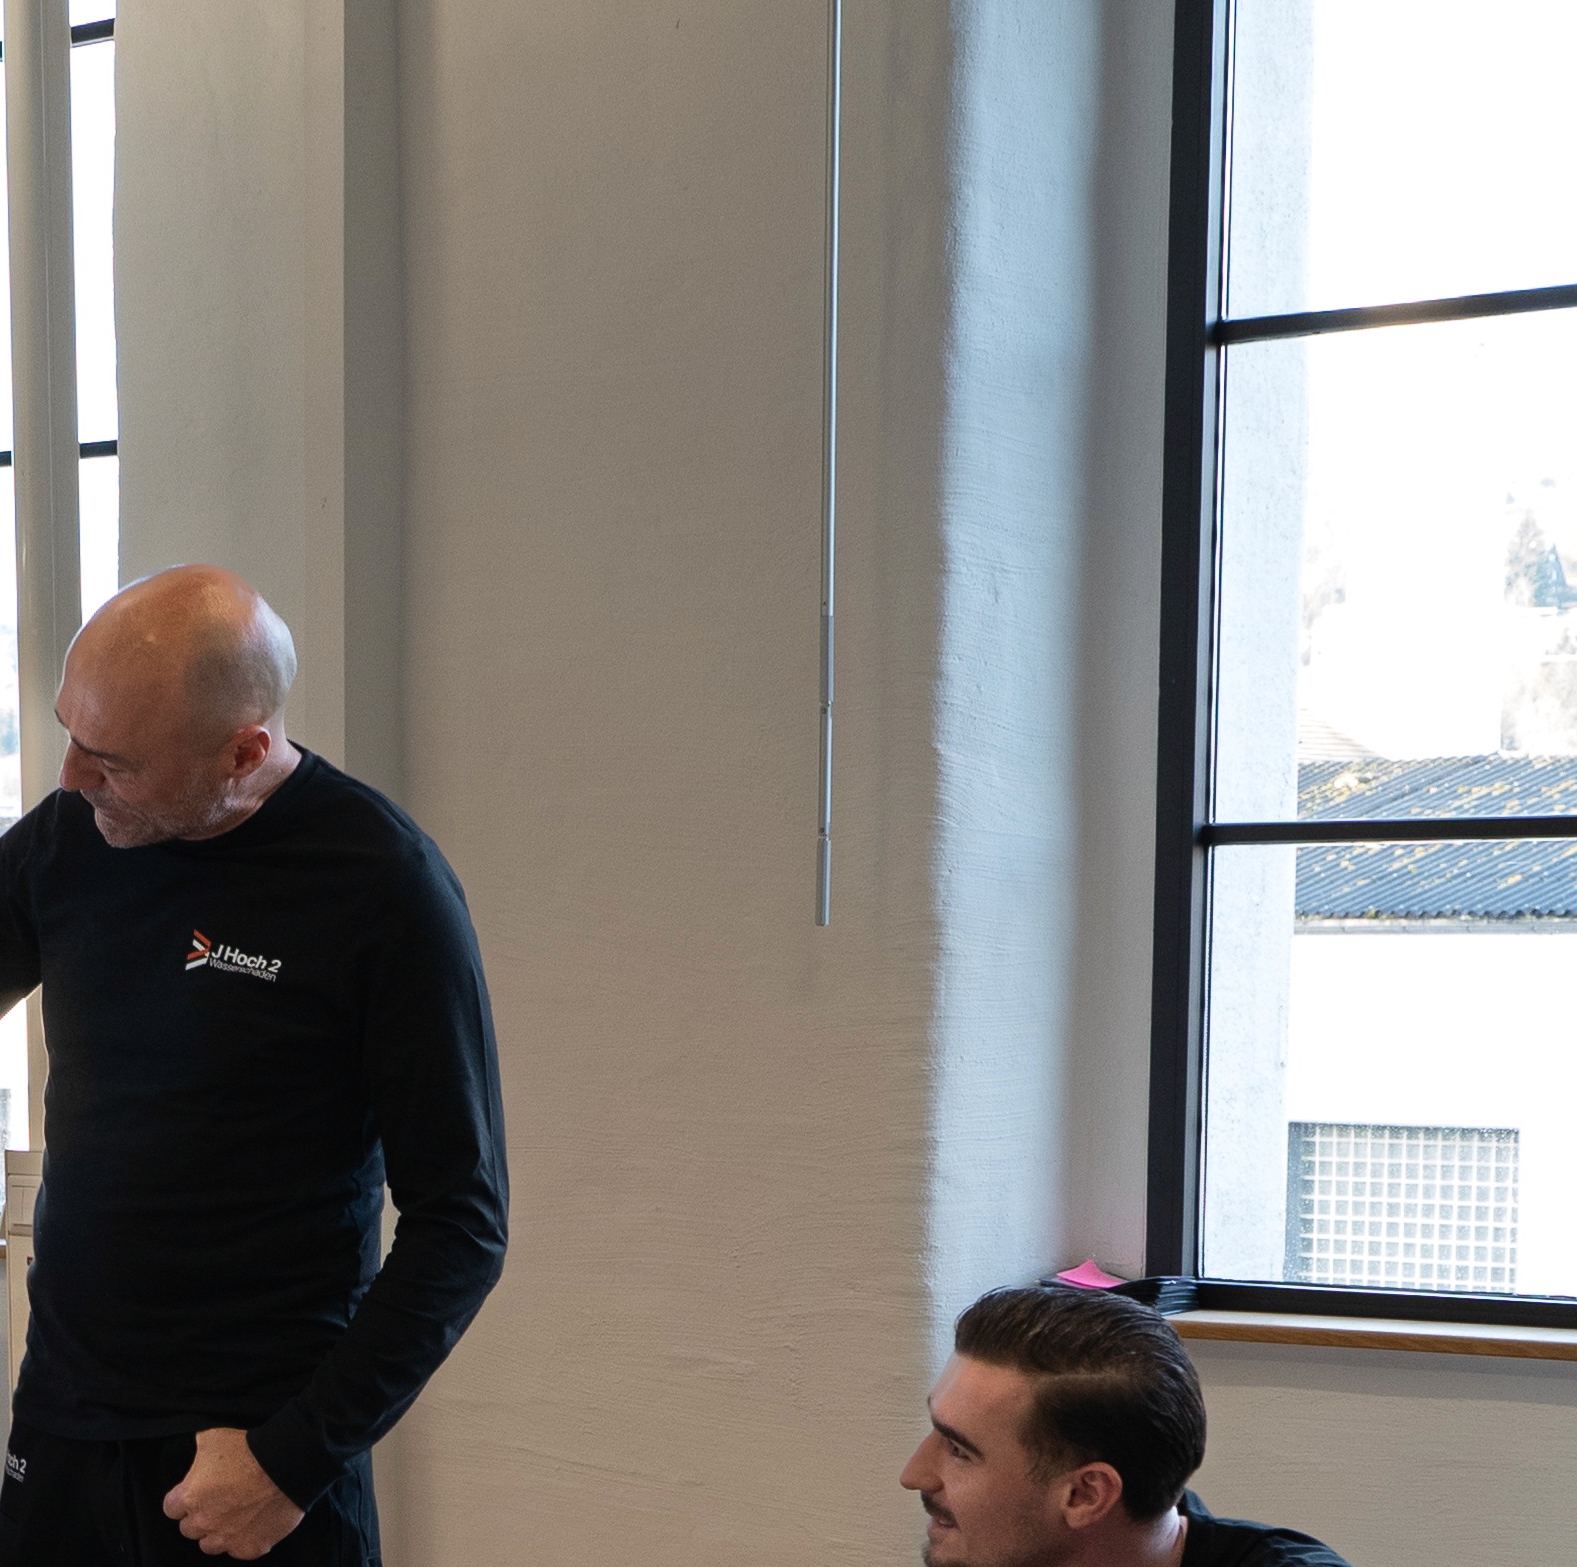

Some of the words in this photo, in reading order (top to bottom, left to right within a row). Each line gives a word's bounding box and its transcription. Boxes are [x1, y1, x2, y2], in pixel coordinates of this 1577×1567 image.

[209, 957, 277, 982] Wasserschaden
[211, 944, 224, 958] J
[224, 945, 267, 970] Hoch
[268, 959, 282, 973] 2
[19, 1458, 27, 1474] 2
